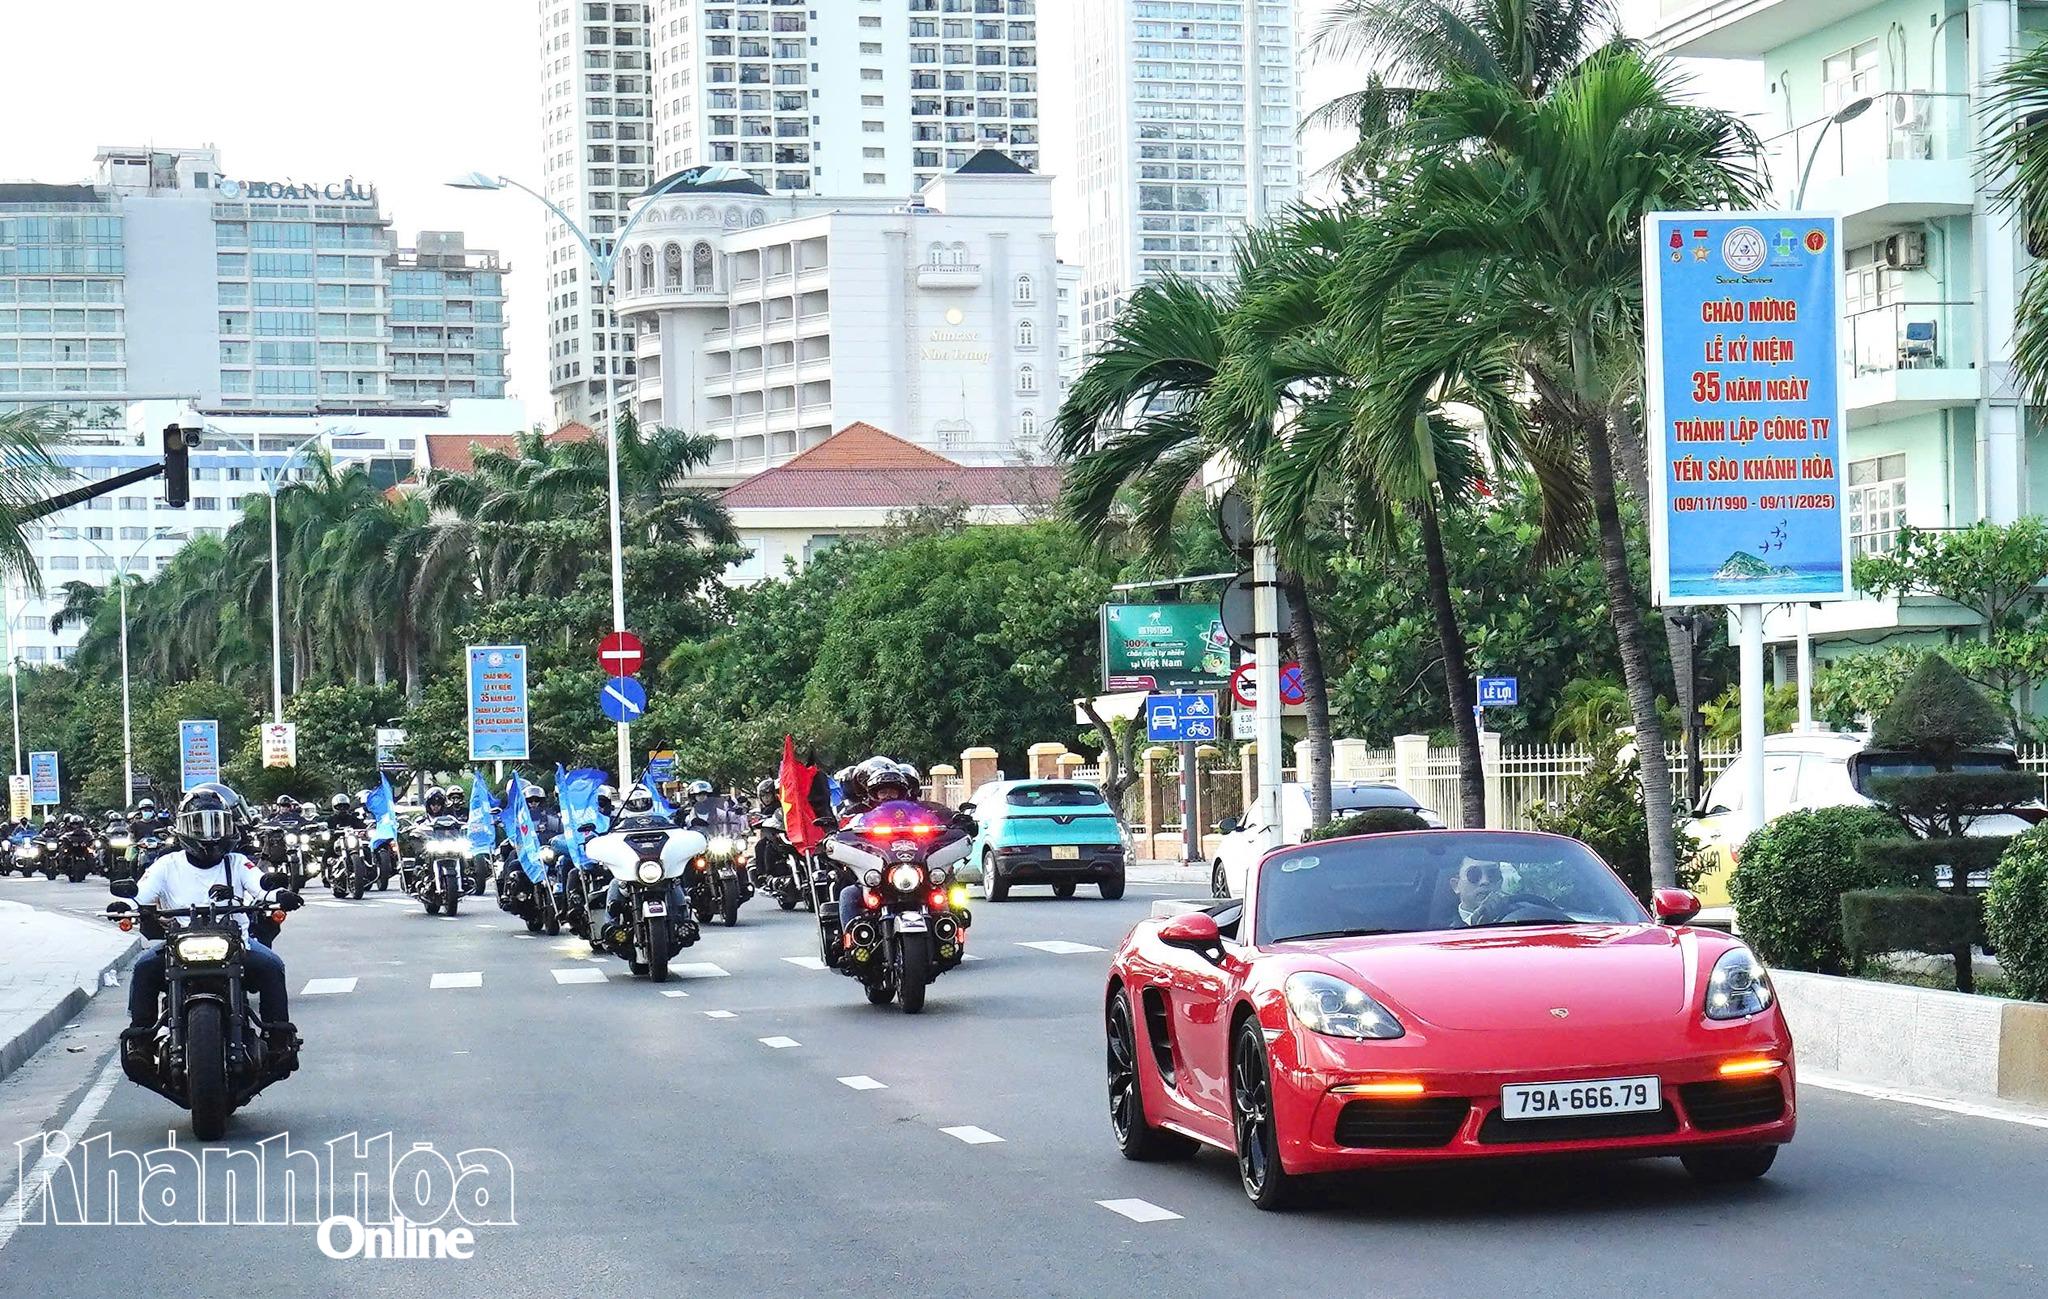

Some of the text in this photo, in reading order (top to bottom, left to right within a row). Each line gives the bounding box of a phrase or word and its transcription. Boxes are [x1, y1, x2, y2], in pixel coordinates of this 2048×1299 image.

[247, 175, 373, 201] HOÀN CẦU
[1702, 297, 1797, 323] CHÀO MỪNG
[1705, 335, 1794, 365] LỄ KỶ NIỆM
[1692, 371, 1810, 403] 35 NĂM NGÀY
[1674, 416, 1830, 446] THÀNH LẬP CÔNG TY
[1673, 454, 1834, 481] YẾN SÀO KHÁNH HÒA
[1674, 497, 1747, 512] (09/11/1990
[1760, 494, 1835, 509] 09/11/2025)
[1125, 640, 1149, 648] 100%
[1141, 658, 1160, 669] Việt
[1162, 659, 1182, 668] Nam
[1483, 685, 1496, 699] LÊ
[1516, 1083, 1647, 1113] 79A-666.79
